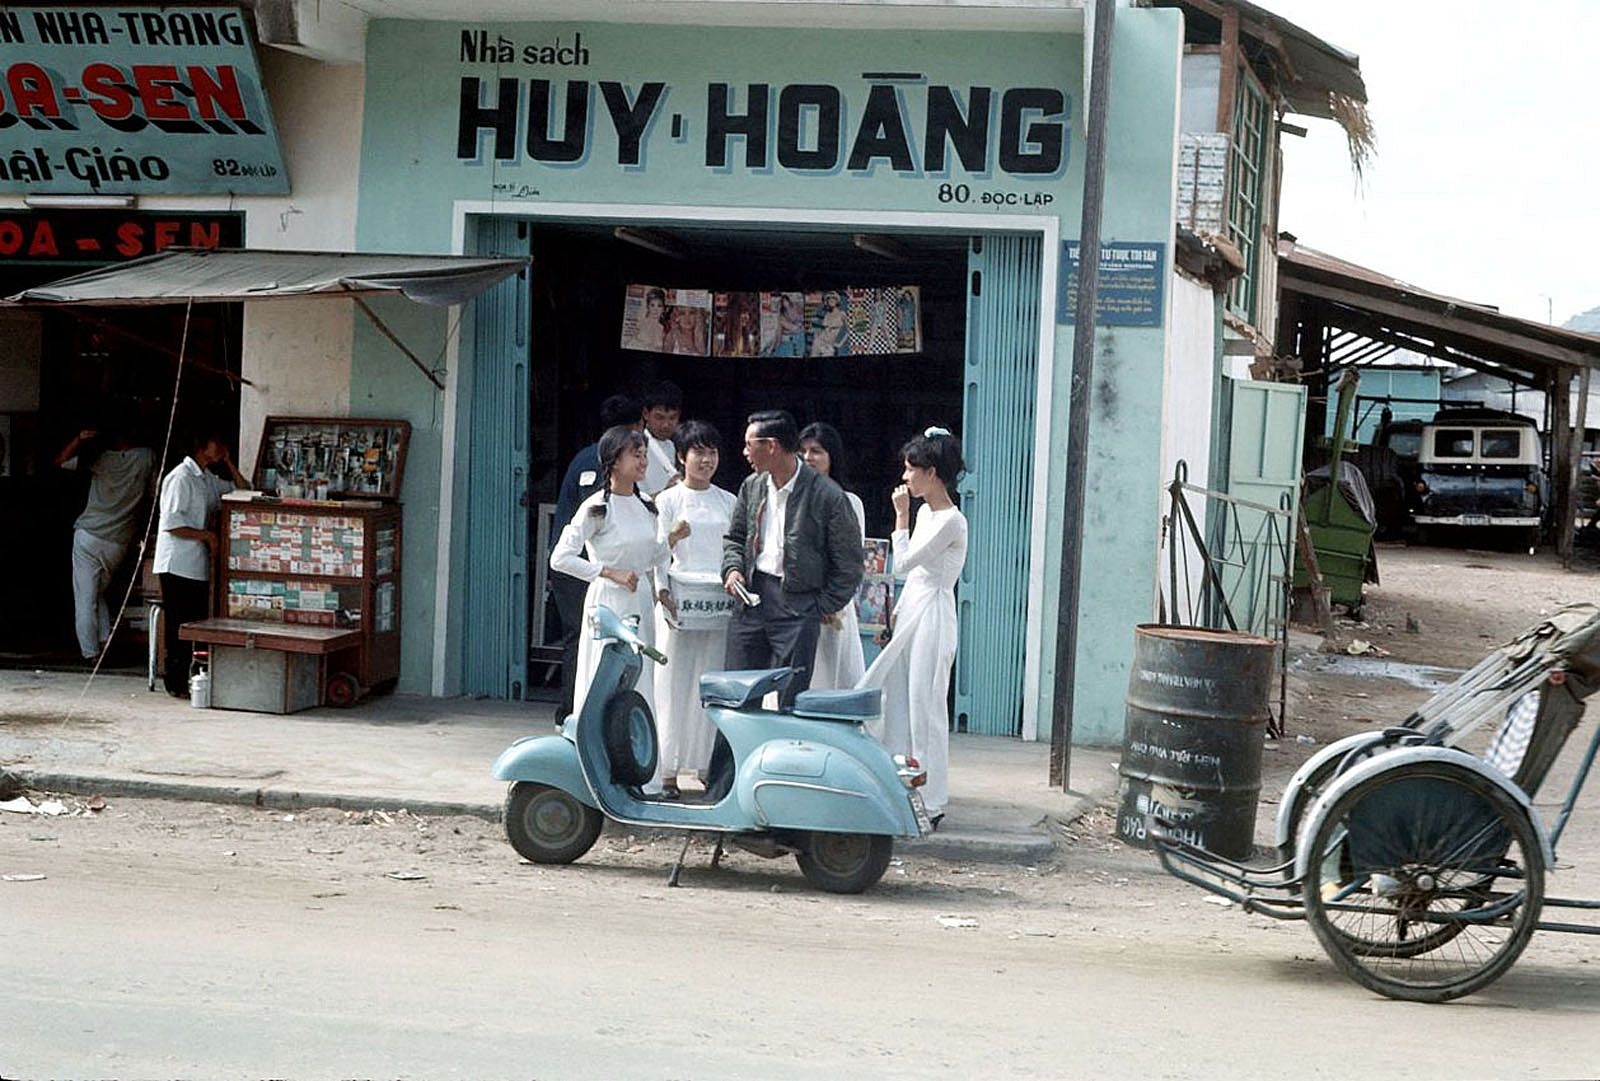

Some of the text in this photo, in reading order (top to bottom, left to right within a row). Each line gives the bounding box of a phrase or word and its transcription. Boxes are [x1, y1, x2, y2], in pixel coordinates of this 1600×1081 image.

[33, 12, 245, 46] NHA-TRANG
[460, 30, 515, 64] Nhà
[0, 62, 248, 122] A-SEN
[457, 76, 667, 167] HUY
[212, 158, 241, 176] 82
